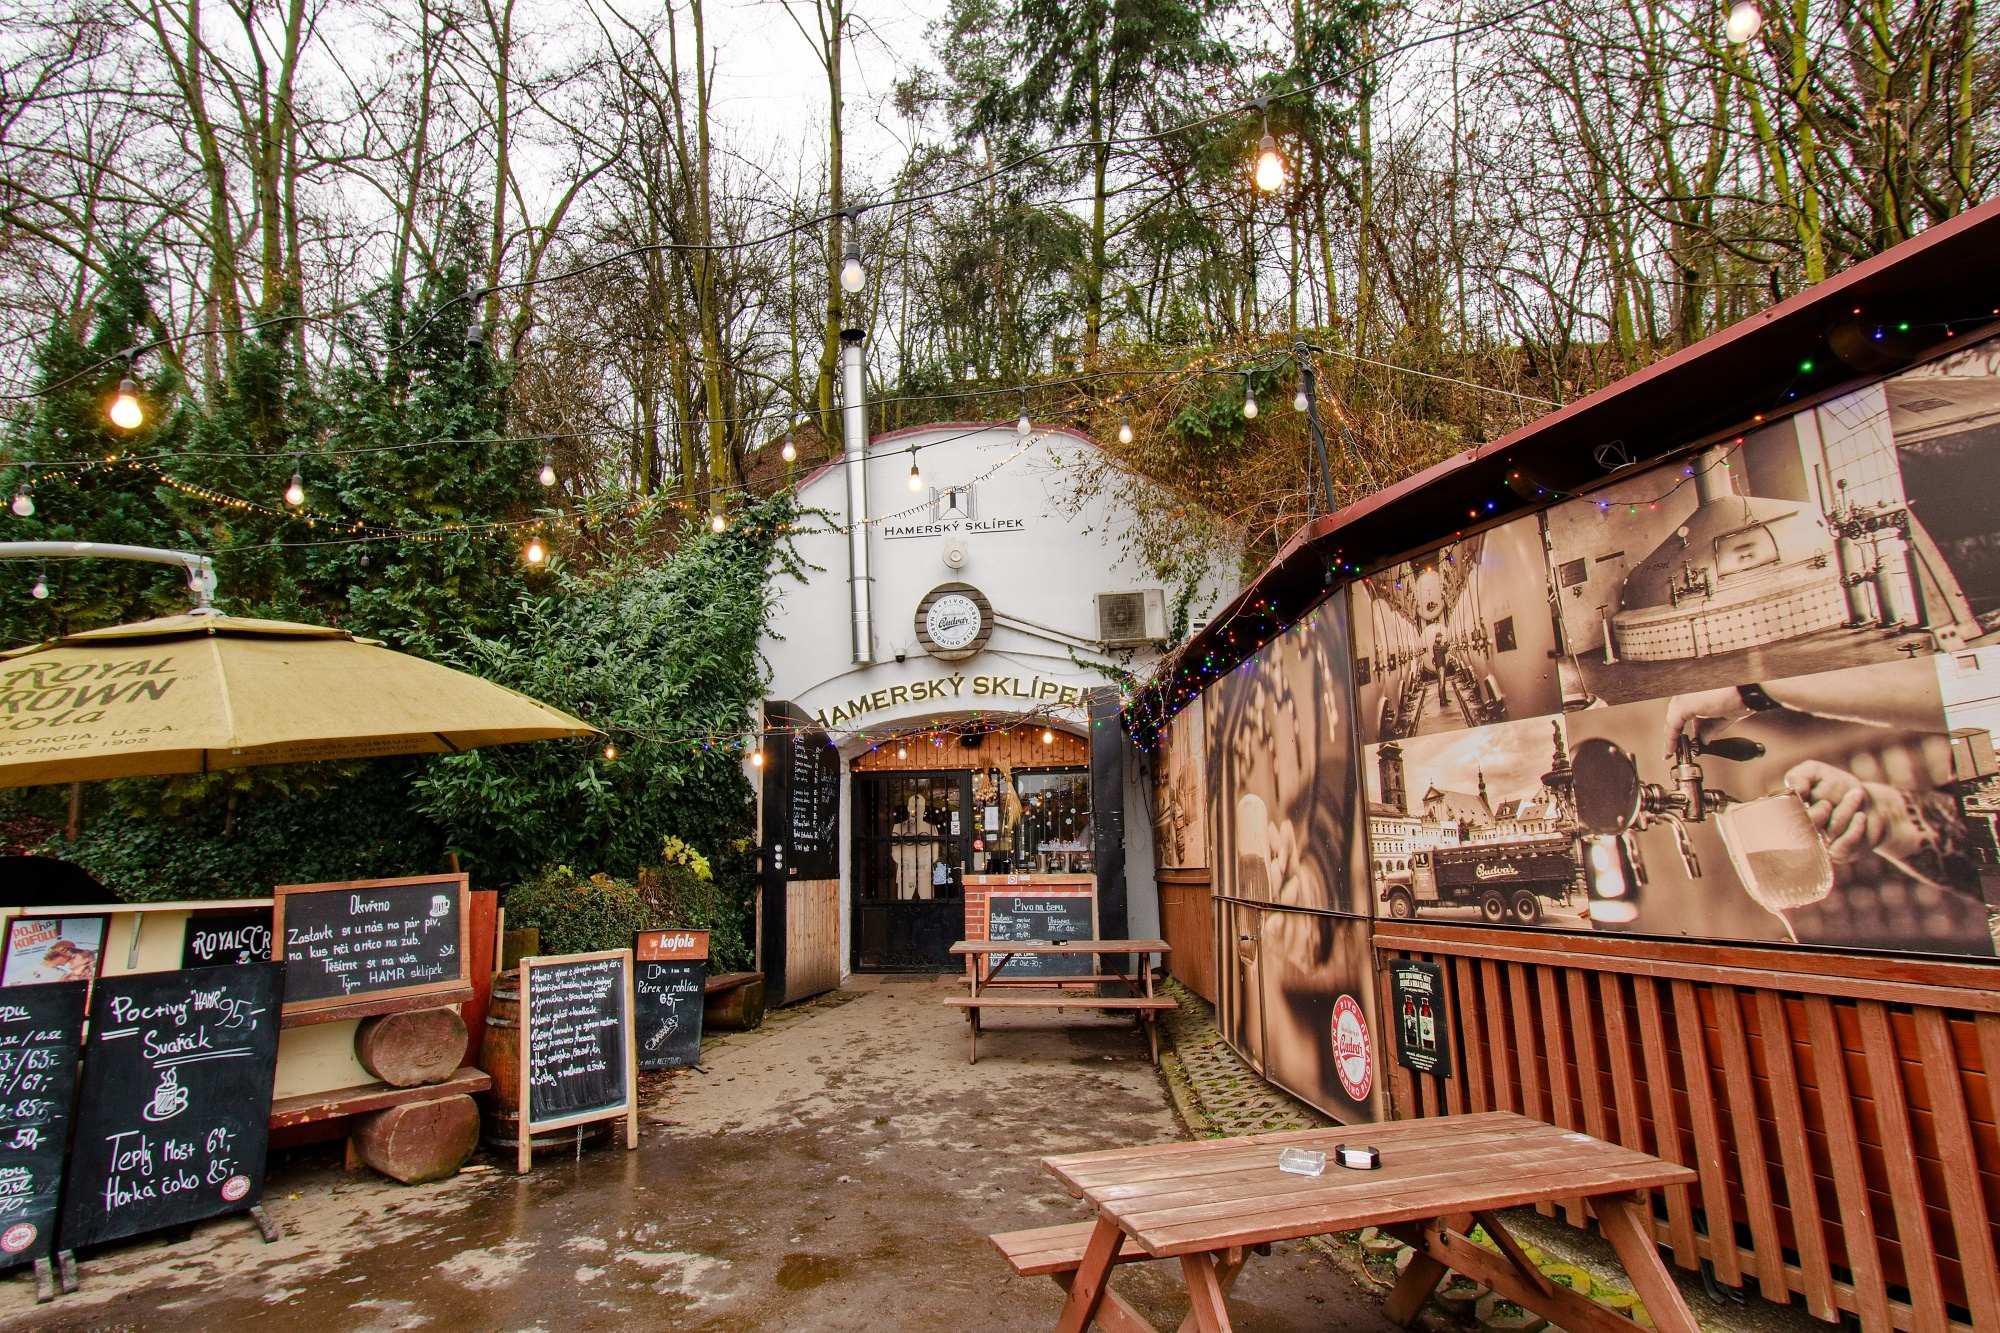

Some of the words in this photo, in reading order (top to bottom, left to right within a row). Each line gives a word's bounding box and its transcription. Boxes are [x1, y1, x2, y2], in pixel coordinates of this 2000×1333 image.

[884, 522, 959, 536] HAMERSKÝ
[966, 518, 1025, 531] SKLÍPEK
[5, 656, 177, 690] ROYAL
[0, 677, 178, 714] ROWN
[0, 732, 98, 748] EORGIA,
[1476, 863, 1519, 879] Budvar
[388, 922, 400, 930] na
[192, 929, 243, 960] ROYAL
[288, 952, 303, 961] na
[310, 945, 328, 958] kus
[386, 939, 398, 947] na
[660, 933, 695, 951] kofola
[382, 957, 394, 966] na
[369, 967, 405, 983] HAMR
[1340, 1000, 1357, 1014] PIVO
